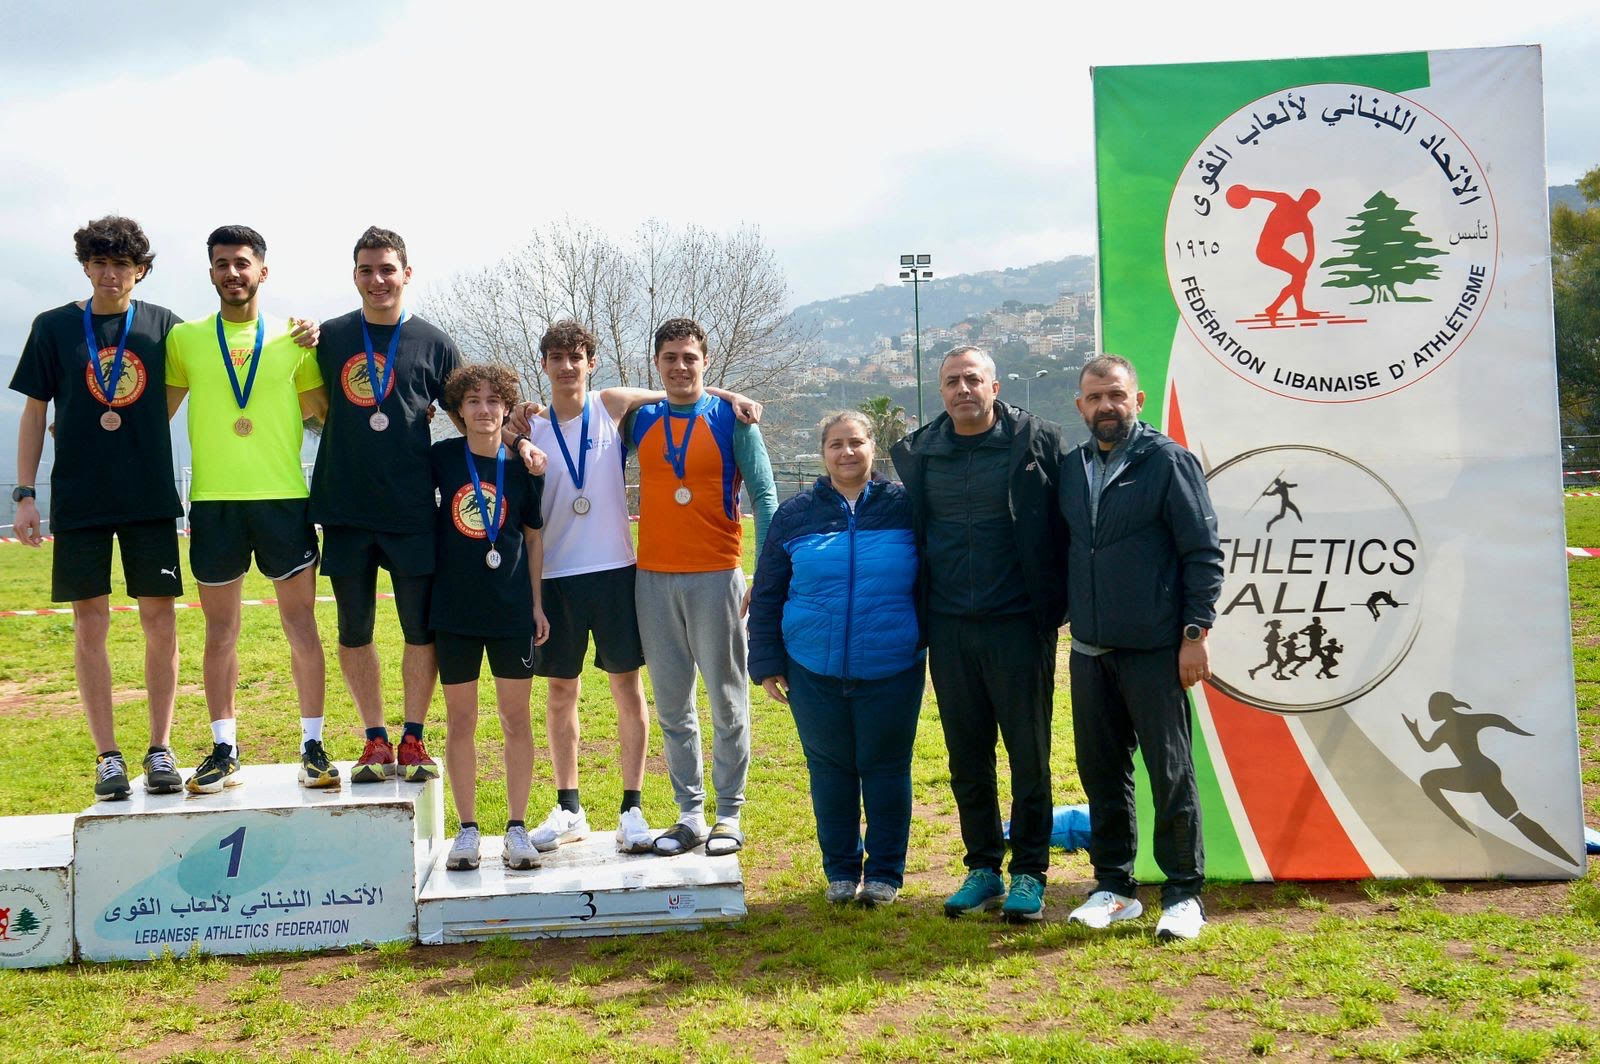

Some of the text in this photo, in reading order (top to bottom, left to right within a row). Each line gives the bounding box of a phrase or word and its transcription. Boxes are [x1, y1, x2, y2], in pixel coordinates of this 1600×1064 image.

[1235, 92, 1307, 145] لألعاب
[1321, 93, 1418, 135] اللبناني
[1193, 144, 1233, 217] القوى
[1448, 219, 1489, 246] تأسس
[1180, 275, 1266, 375] FÉDÉRATION
[1272, 367, 1381, 393] LIBANAISE
[1412, 264, 1486, 368] ATHLÉTISME
[1218, 538, 1417, 576] HLETICS
[1220, 580, 1346, 616] ALL
[218, 826, 247, 879] 1
[104, 896, 161, 923] القوى
[170, 890, 231, 919] لألعاب
[240, 888, 312, 919] اللبناني
[577, 892, 597, 921] 3
[135, 919, 350, 945] LEBANESE ATHLETICS FEDERATION
